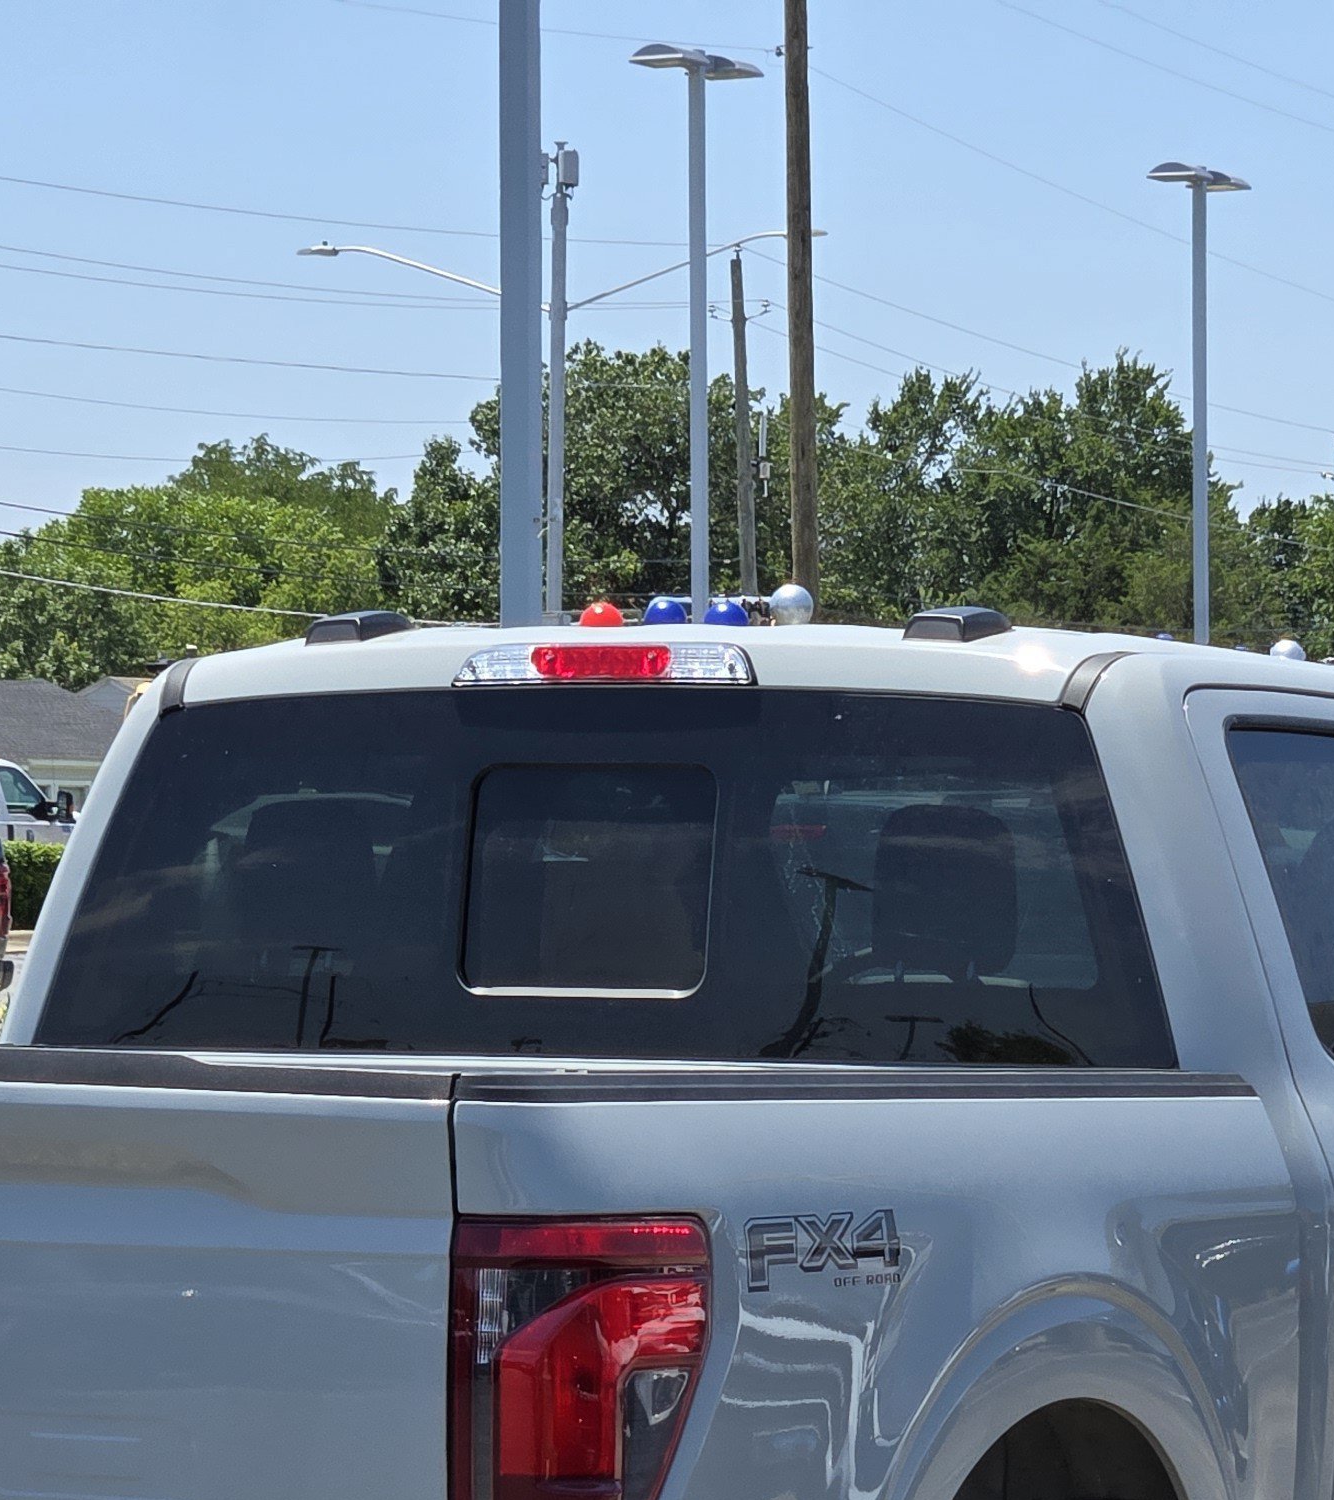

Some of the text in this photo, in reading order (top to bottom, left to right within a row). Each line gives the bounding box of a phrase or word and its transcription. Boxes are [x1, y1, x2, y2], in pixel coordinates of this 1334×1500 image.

[744, 1209, 903, 1293] FX4
[833, 1273, 902, 1288] OFF ROAD
